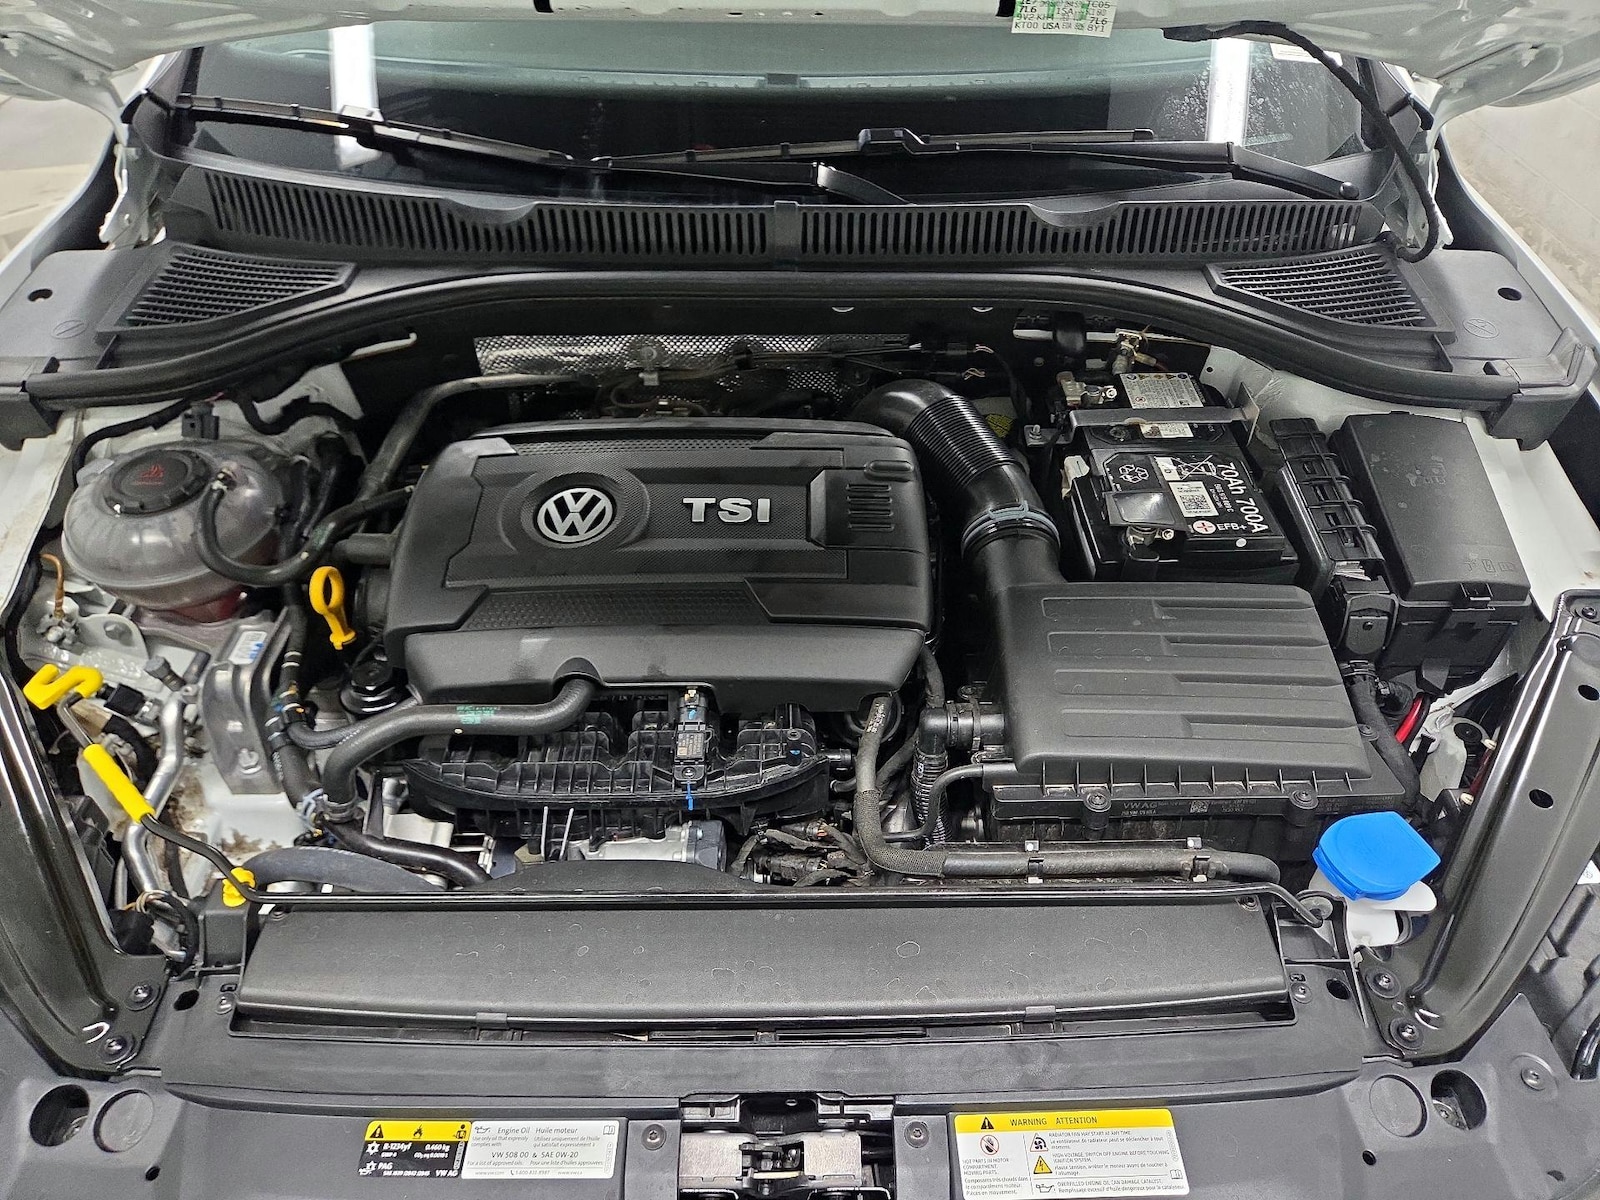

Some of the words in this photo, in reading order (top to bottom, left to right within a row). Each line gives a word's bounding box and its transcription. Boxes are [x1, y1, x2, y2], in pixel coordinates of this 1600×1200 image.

[1217, 462, 1247, 494] 70Ah
[1236, 498, 1268, 533] 700A
[683, 497, 770, 523] TSI
[1010, 1118, 1047, 1126] WARNING
[1056, 1116, 1098, 1124] ATTENTION
[498, 1127, 519, 1136] Engine
[378, 1162, 393, 1170] PAG
